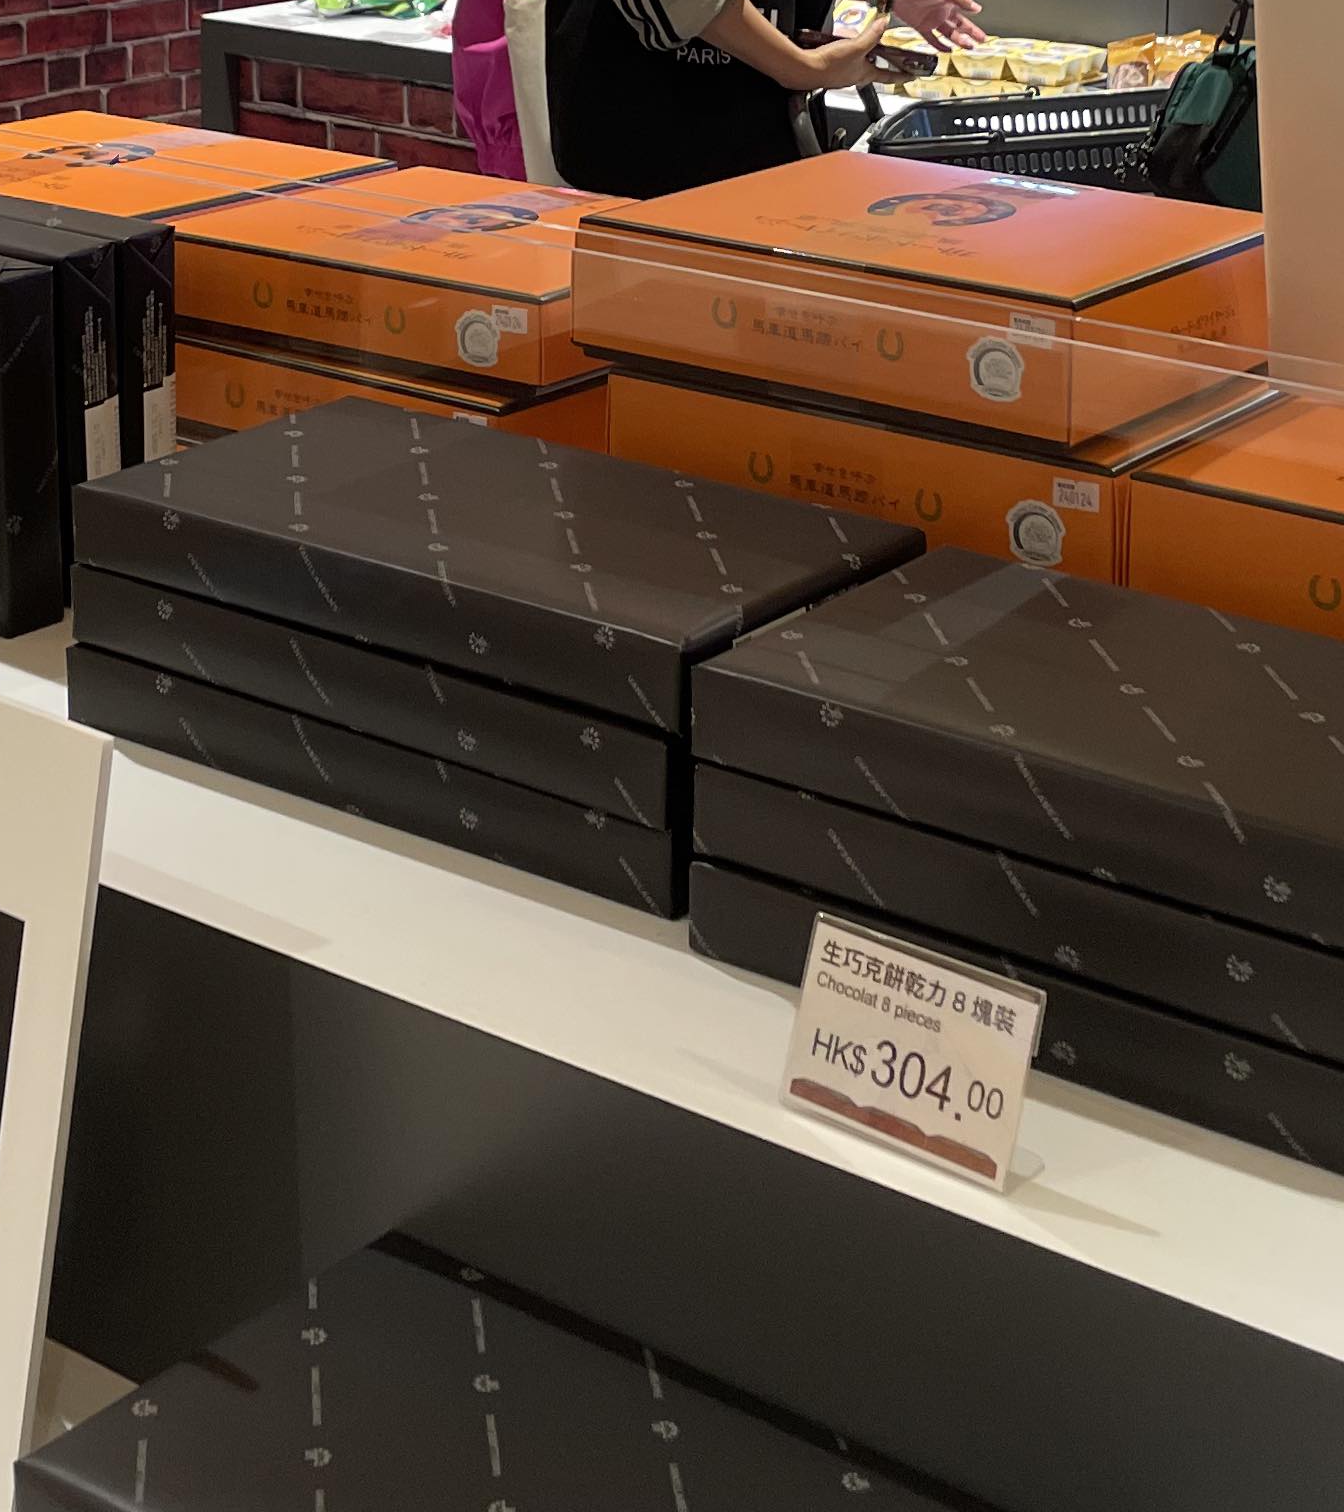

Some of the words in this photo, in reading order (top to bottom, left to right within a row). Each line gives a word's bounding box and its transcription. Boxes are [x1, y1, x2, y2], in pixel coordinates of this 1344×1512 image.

[677, 46, 731, 65] PARIS
[817, 971, 878, 1009] Chocolat
[881, 997, 890, 1013] 8
[894, 1004, 941, 1033] pieces
[821, 940, 947, 1008] 生巧克餅乾力
[952, 992, 966, 1013] 8
